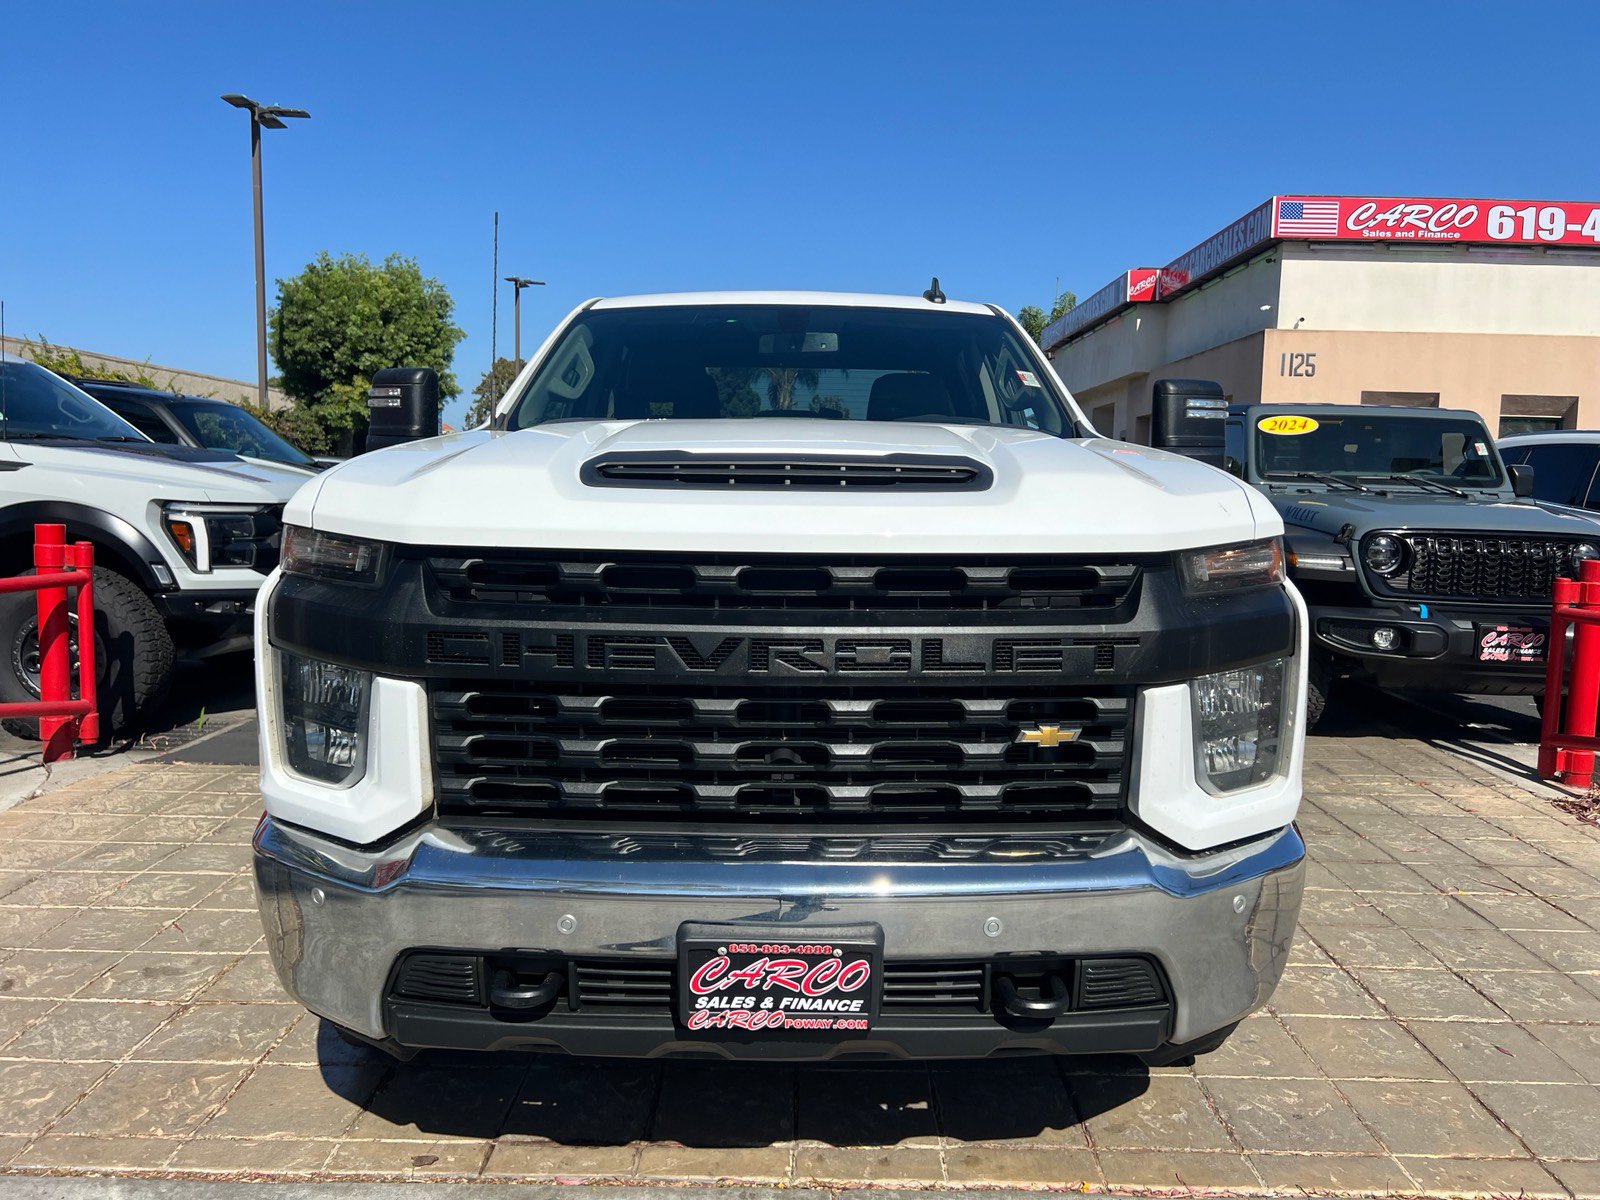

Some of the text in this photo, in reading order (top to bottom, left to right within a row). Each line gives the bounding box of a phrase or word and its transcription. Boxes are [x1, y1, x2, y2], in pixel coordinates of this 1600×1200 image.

[1346, 201, 1479, 232] CARCO
[1189, 204, 1271, 280] CARCOSALES.COM
[1362, 229, 1461, 239] Sales and Finance
[1280, 352, 1317, 377] 1125
[1268, 419, 1309, 431] 2024
[1481, 631, 1545, 649] CARCO
[424, 630, 1141, 674] CHEVROLET
[728, 943, 833, 955] 858-883-4888
[689, 955, 871, 997] CARCO
[695, 996, 864, 1012] SALES & FINANCE
